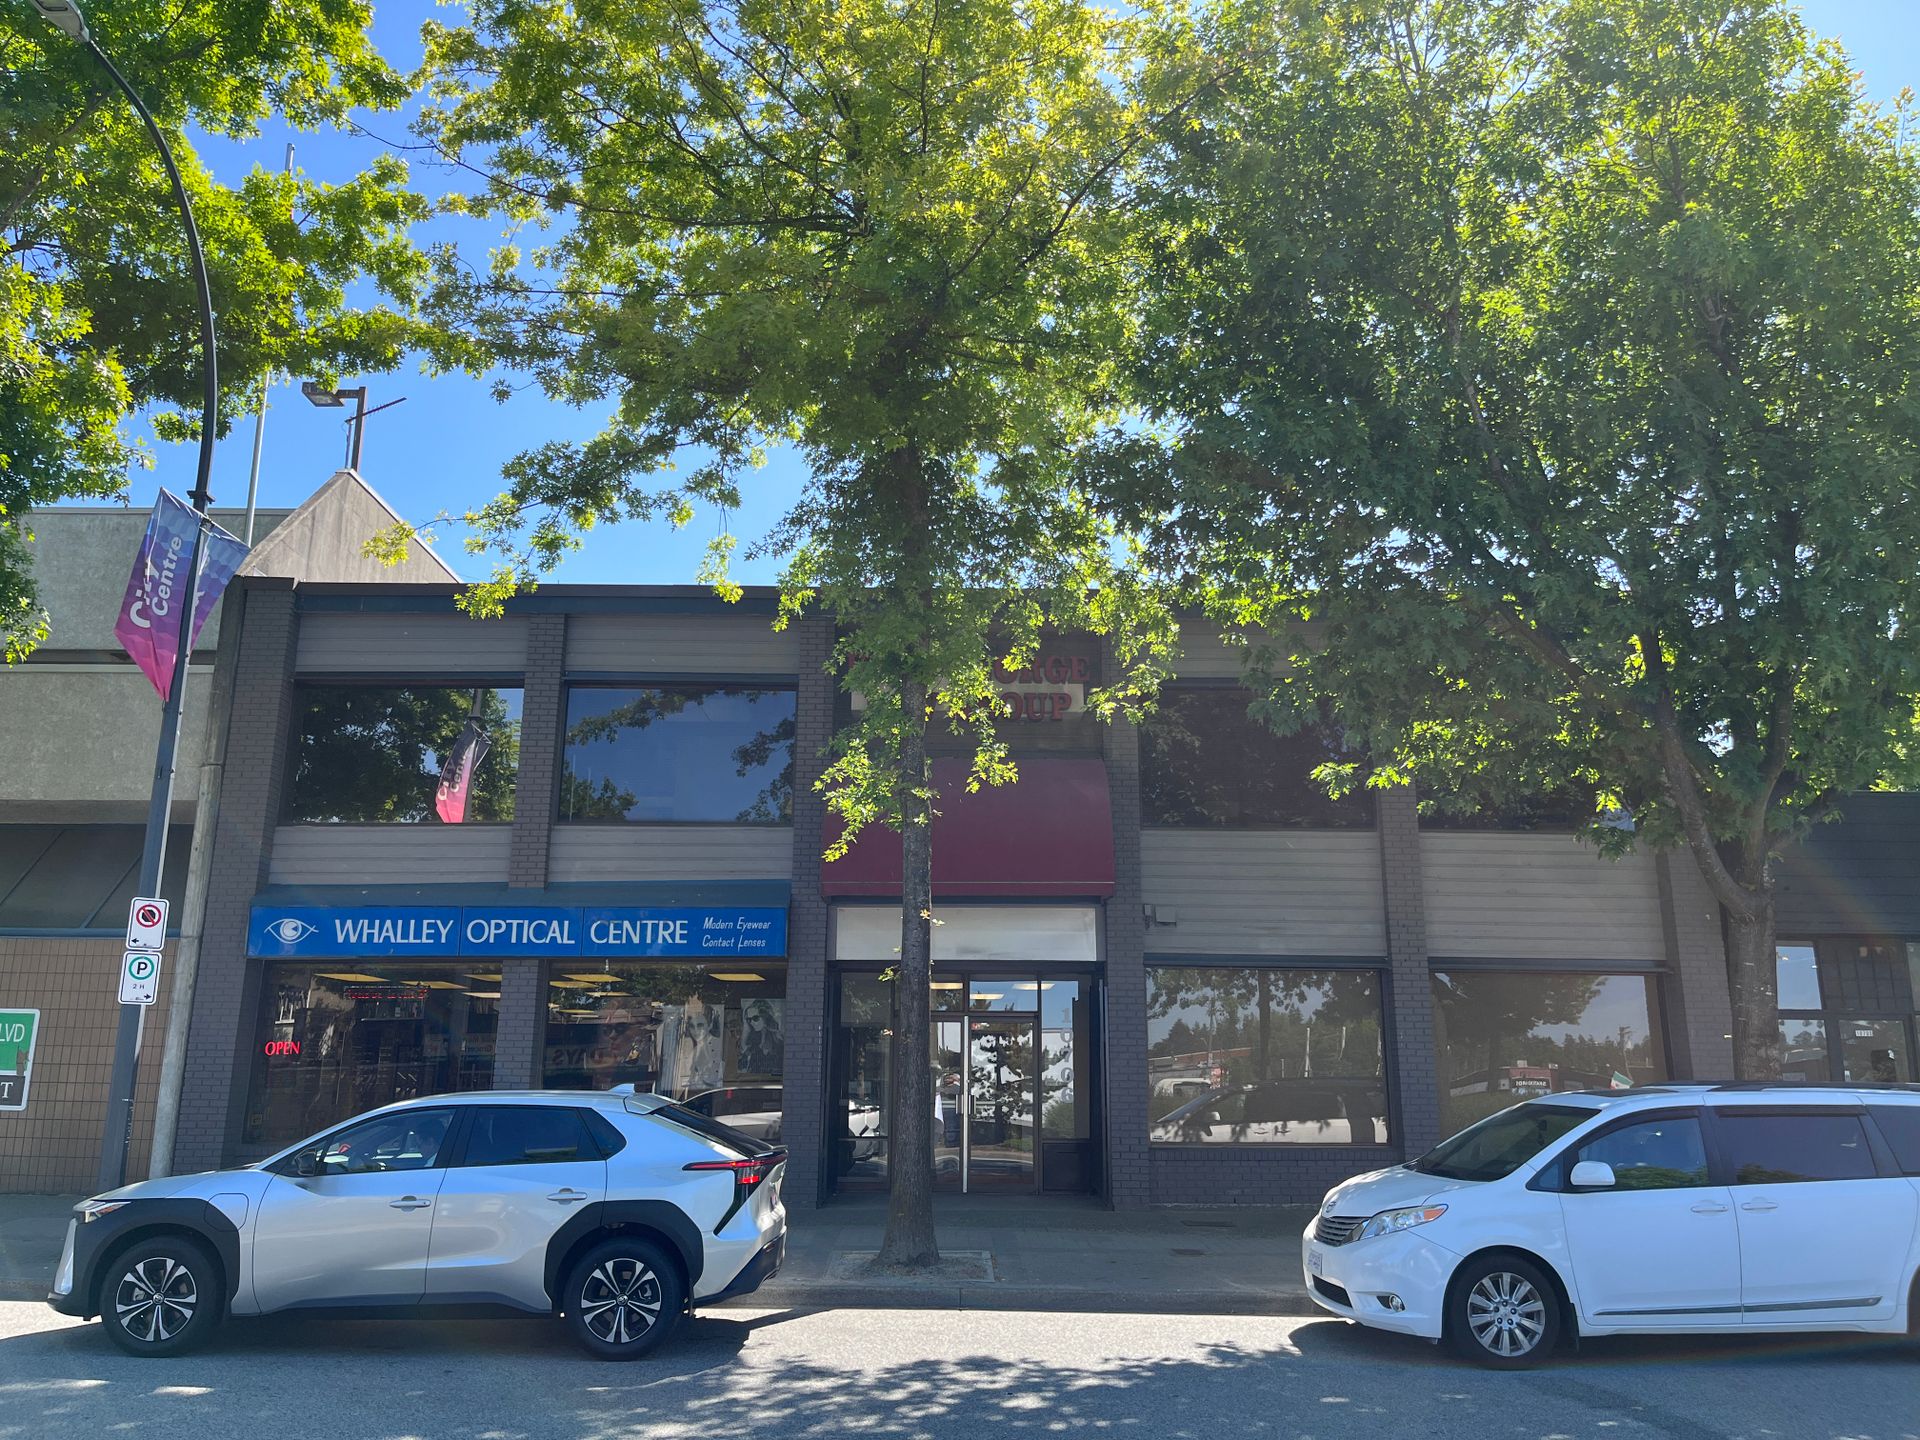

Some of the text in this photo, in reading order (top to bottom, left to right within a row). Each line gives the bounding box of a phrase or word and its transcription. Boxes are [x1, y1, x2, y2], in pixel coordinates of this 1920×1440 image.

[151, 536, 182, 616] Centre
[992, 655, 1090, 684] ORGE
[1000, 691, 1073, 721] OUP
[335, 919, 688, 944] WHALLEY OPTICAL CENTRE
[702, 917, 771, 931] Modern Eyewear
[702, 935, 766, 952] Contact Lenses
[136, 961, 148, 975] P
[0, 1023, 25, 1042] LVD
[264, 1041, 301, 1056] OPEN
